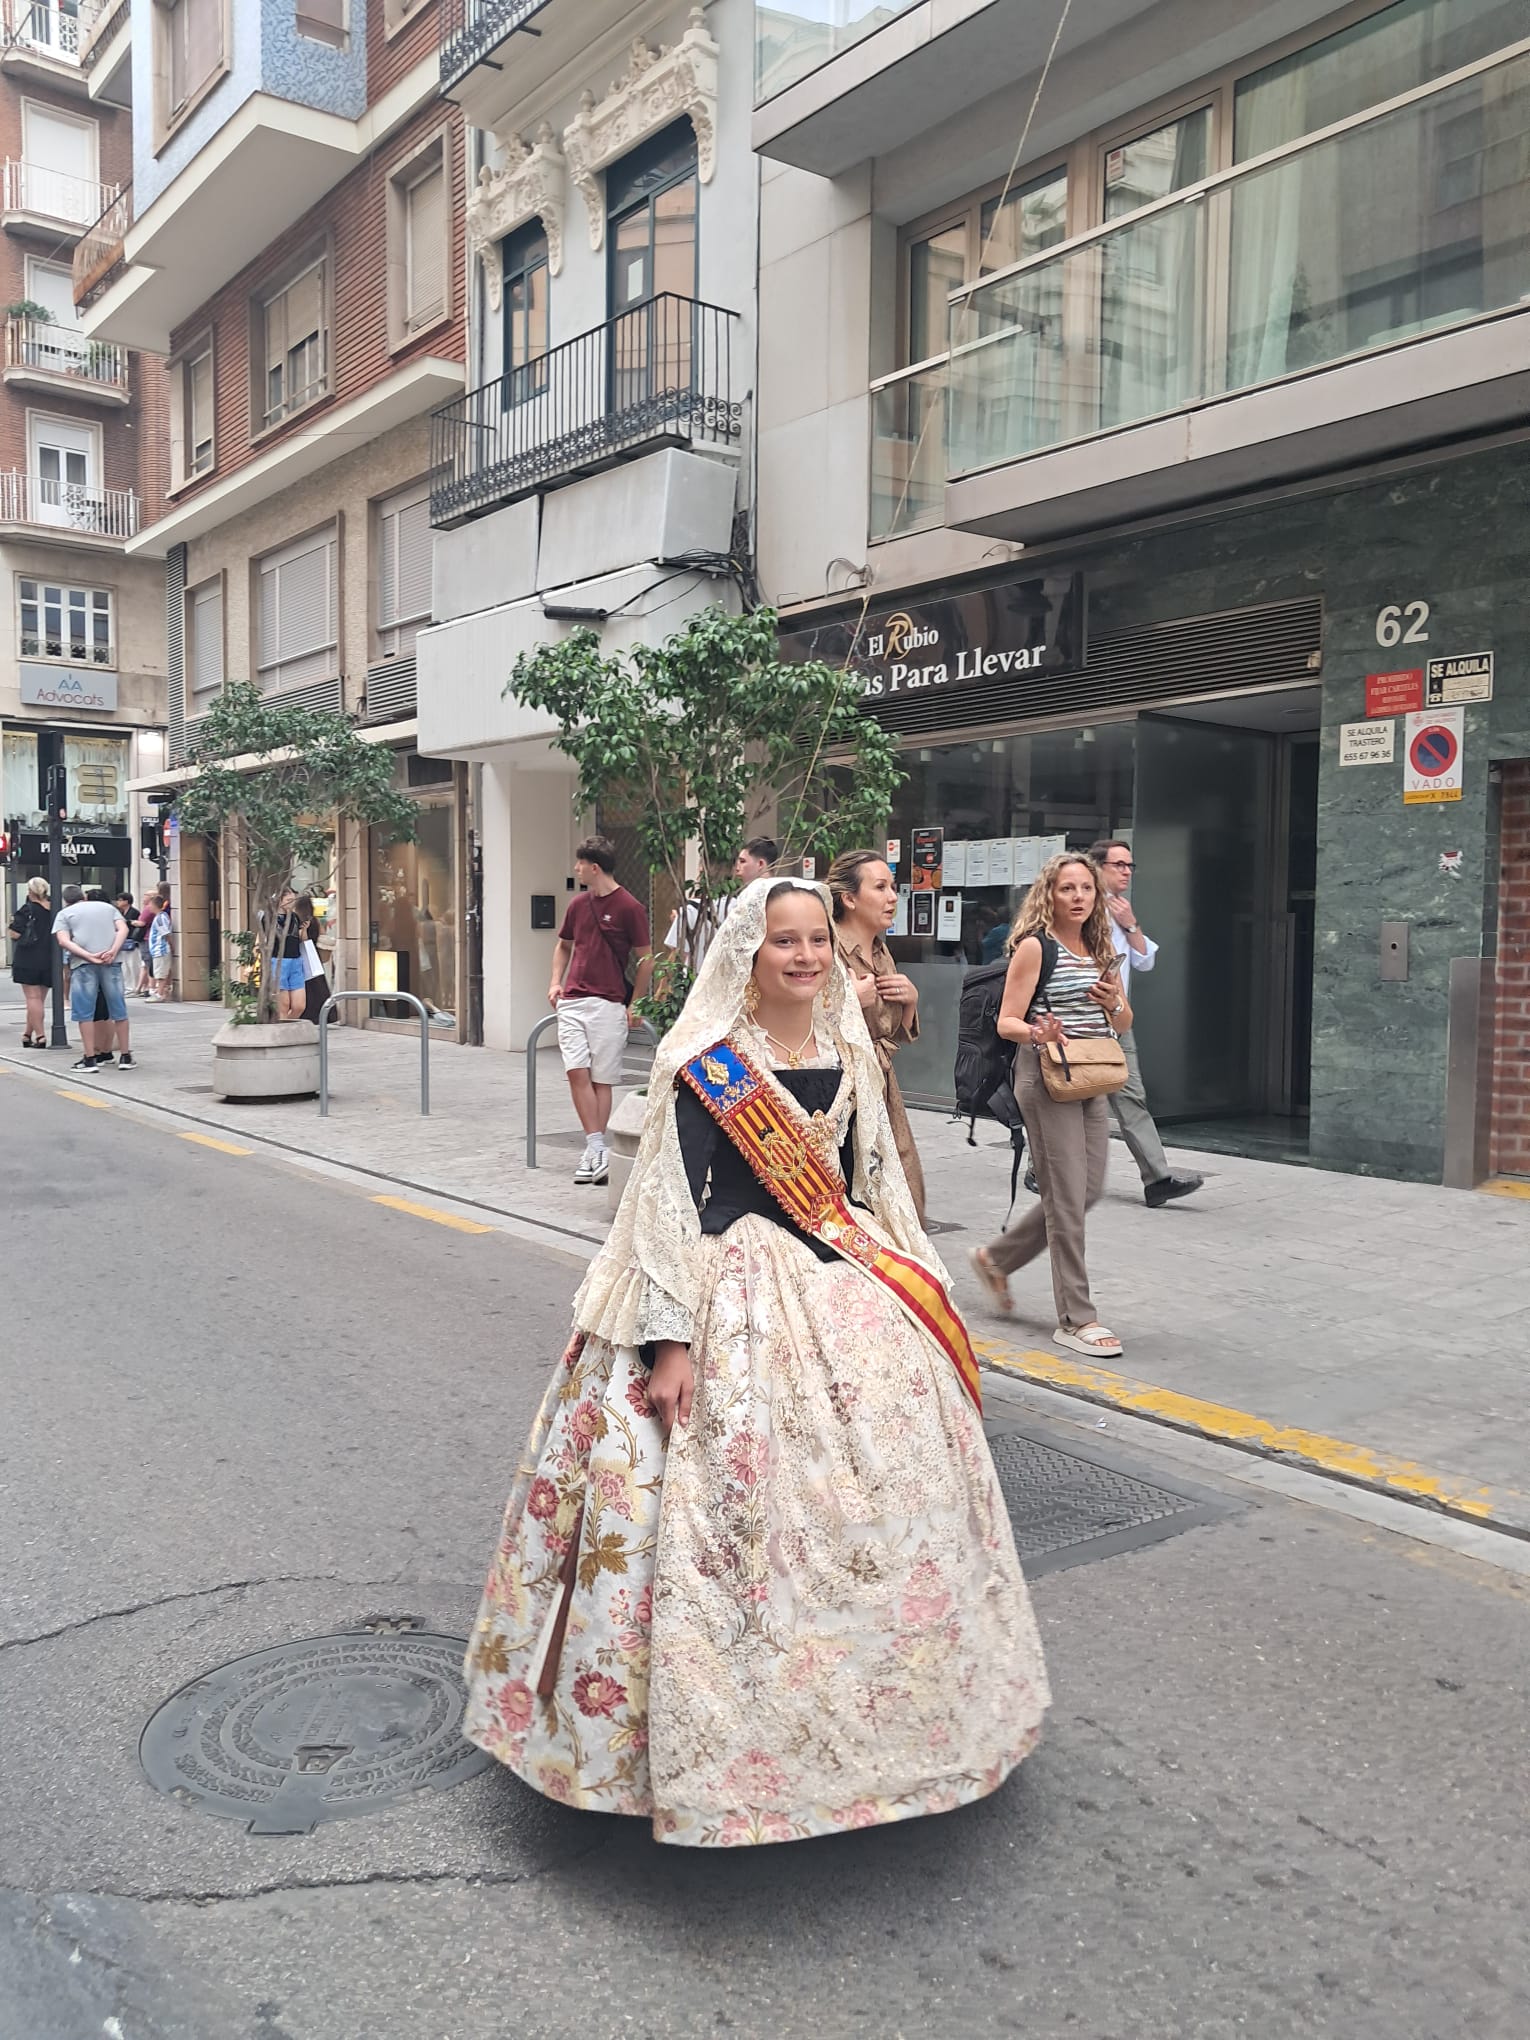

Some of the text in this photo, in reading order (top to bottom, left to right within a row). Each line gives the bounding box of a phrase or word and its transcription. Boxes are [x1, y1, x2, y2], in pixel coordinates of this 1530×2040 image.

[1375, 600, 1430, 648] 62
[867, 612, 939, 662] El Rubio
[889, 663, 949, 692] Para
[955, 643, 1047, 681] Llevar
[1431, 657, 1489, 678] SE ALQUILA
[36, 688, 105, 707] Advocats
[1347, 726, 1388, 737] SE ALQUILA
[1348, 737, 1386, 747] TRASTERO
[1412, 777, 1455, 790] VADO
[40, 842, 96, 855] PRALTA
